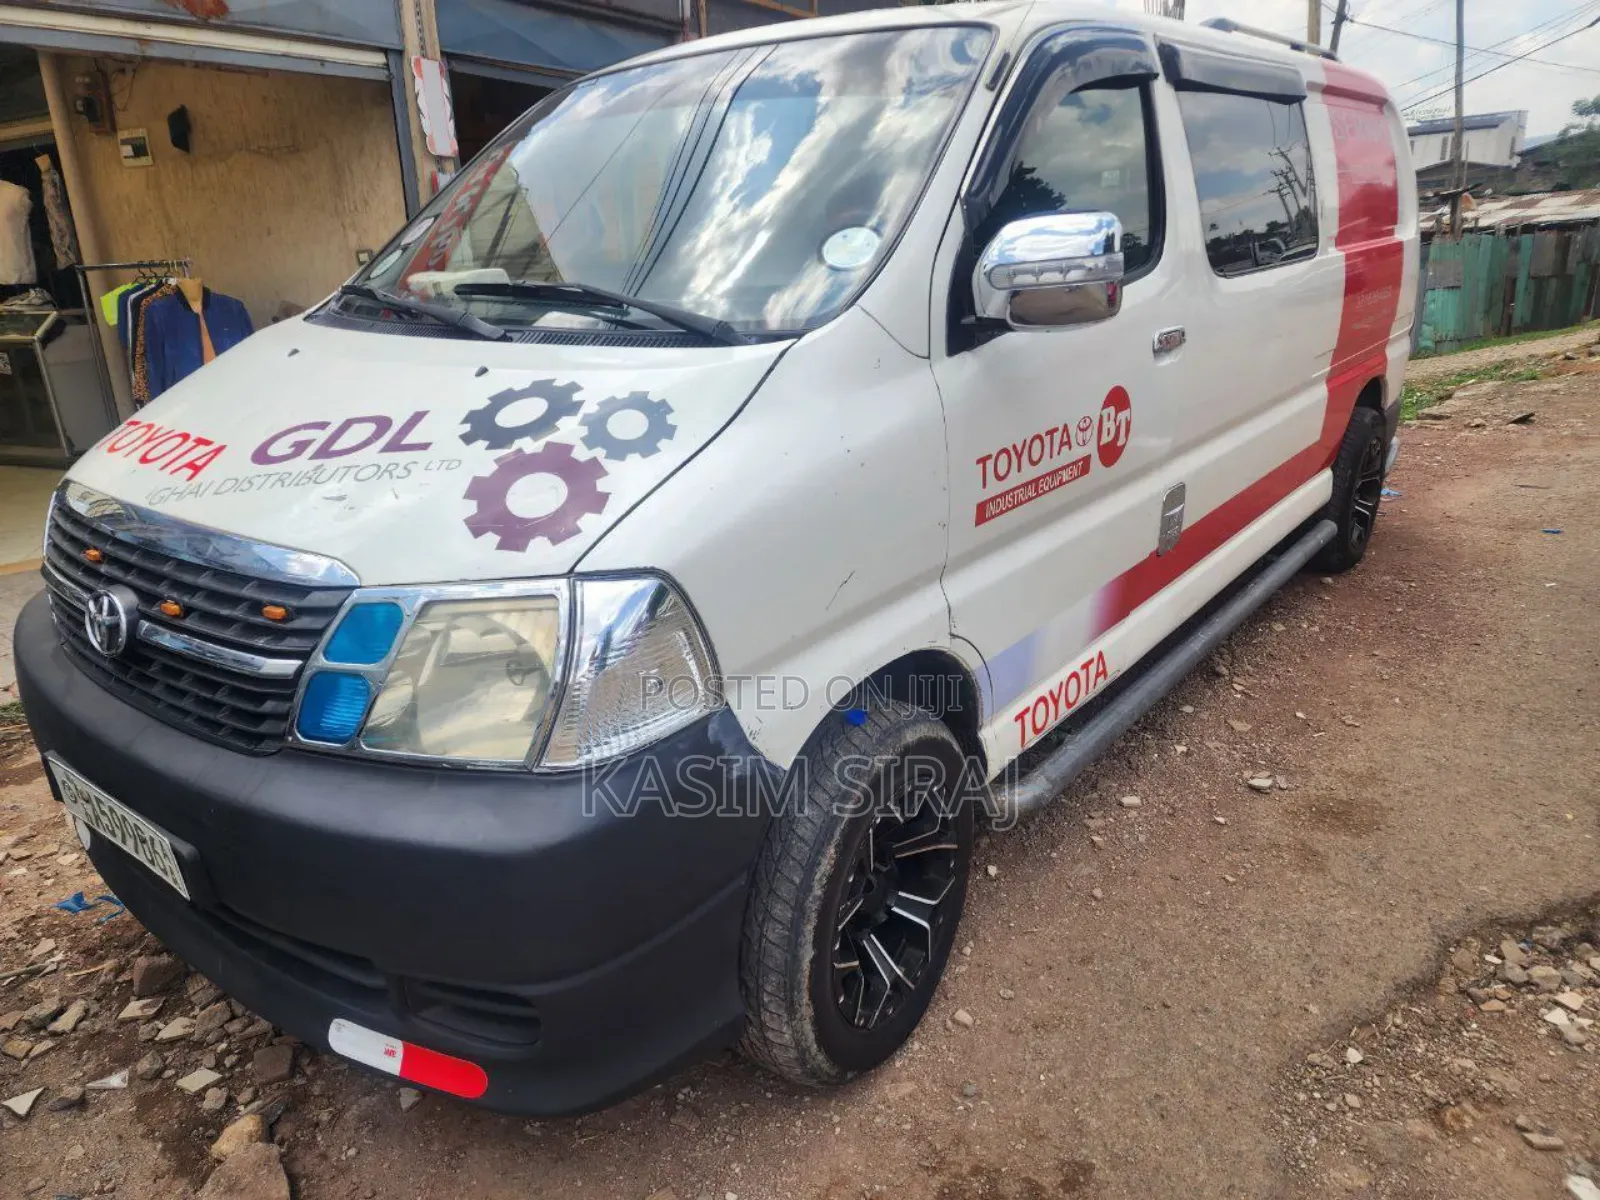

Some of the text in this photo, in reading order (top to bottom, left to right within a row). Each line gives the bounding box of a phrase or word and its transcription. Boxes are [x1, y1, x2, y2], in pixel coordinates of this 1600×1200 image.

[97, 420, 228, 481] TOYOTA
[250, 410, 433, 466] GDL
[975, 405, 1131, 490] TOYOTA BT
[212, 460, 418, 496] DISTRIBUTORS
[424, 459, 463, 471] LTD
[985, 460, 1085, 519] INDUSTRIAL EQUIPMENT
[1014, 650, 1108, 748] TOYOTA
